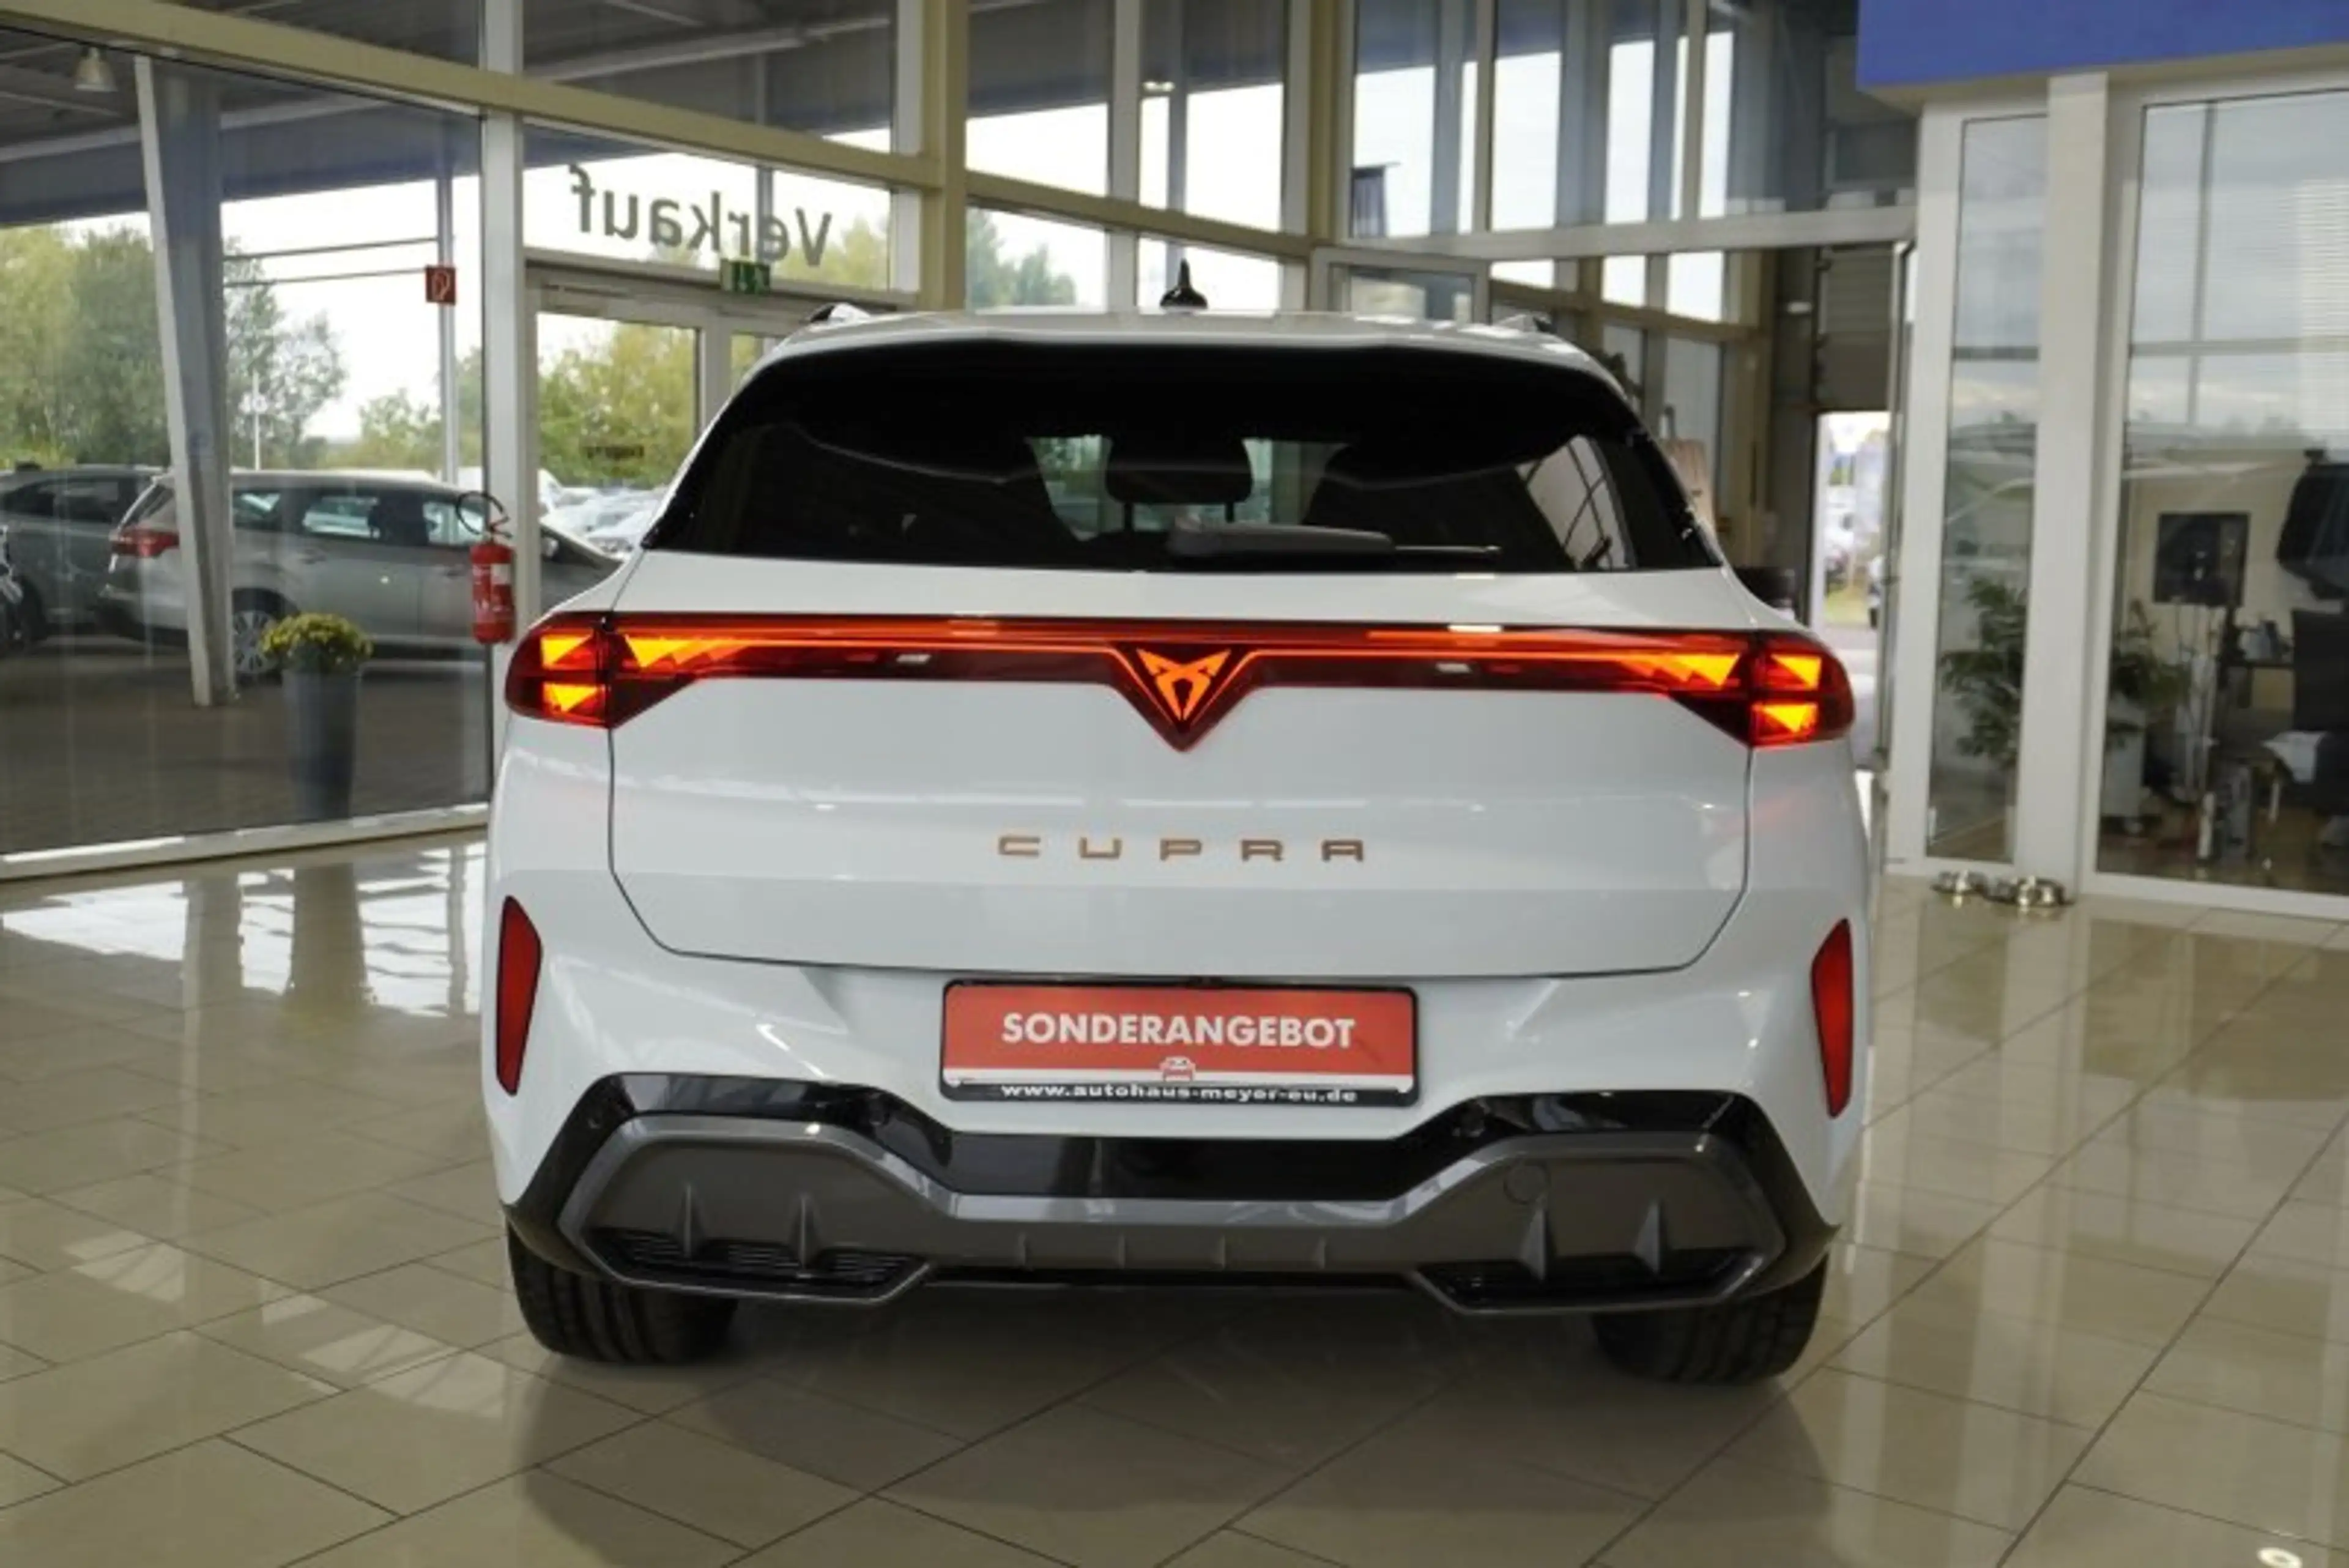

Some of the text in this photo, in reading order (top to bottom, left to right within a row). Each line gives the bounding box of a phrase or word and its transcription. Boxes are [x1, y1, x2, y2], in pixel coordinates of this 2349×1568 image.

[998, 834, 1365, 862] CUPRA
[1001, 1012, 1356, 1048] SONDERANGEBOT
[1001, 1082, 1357, 1102] www.autohaus-meyer-eu.de
